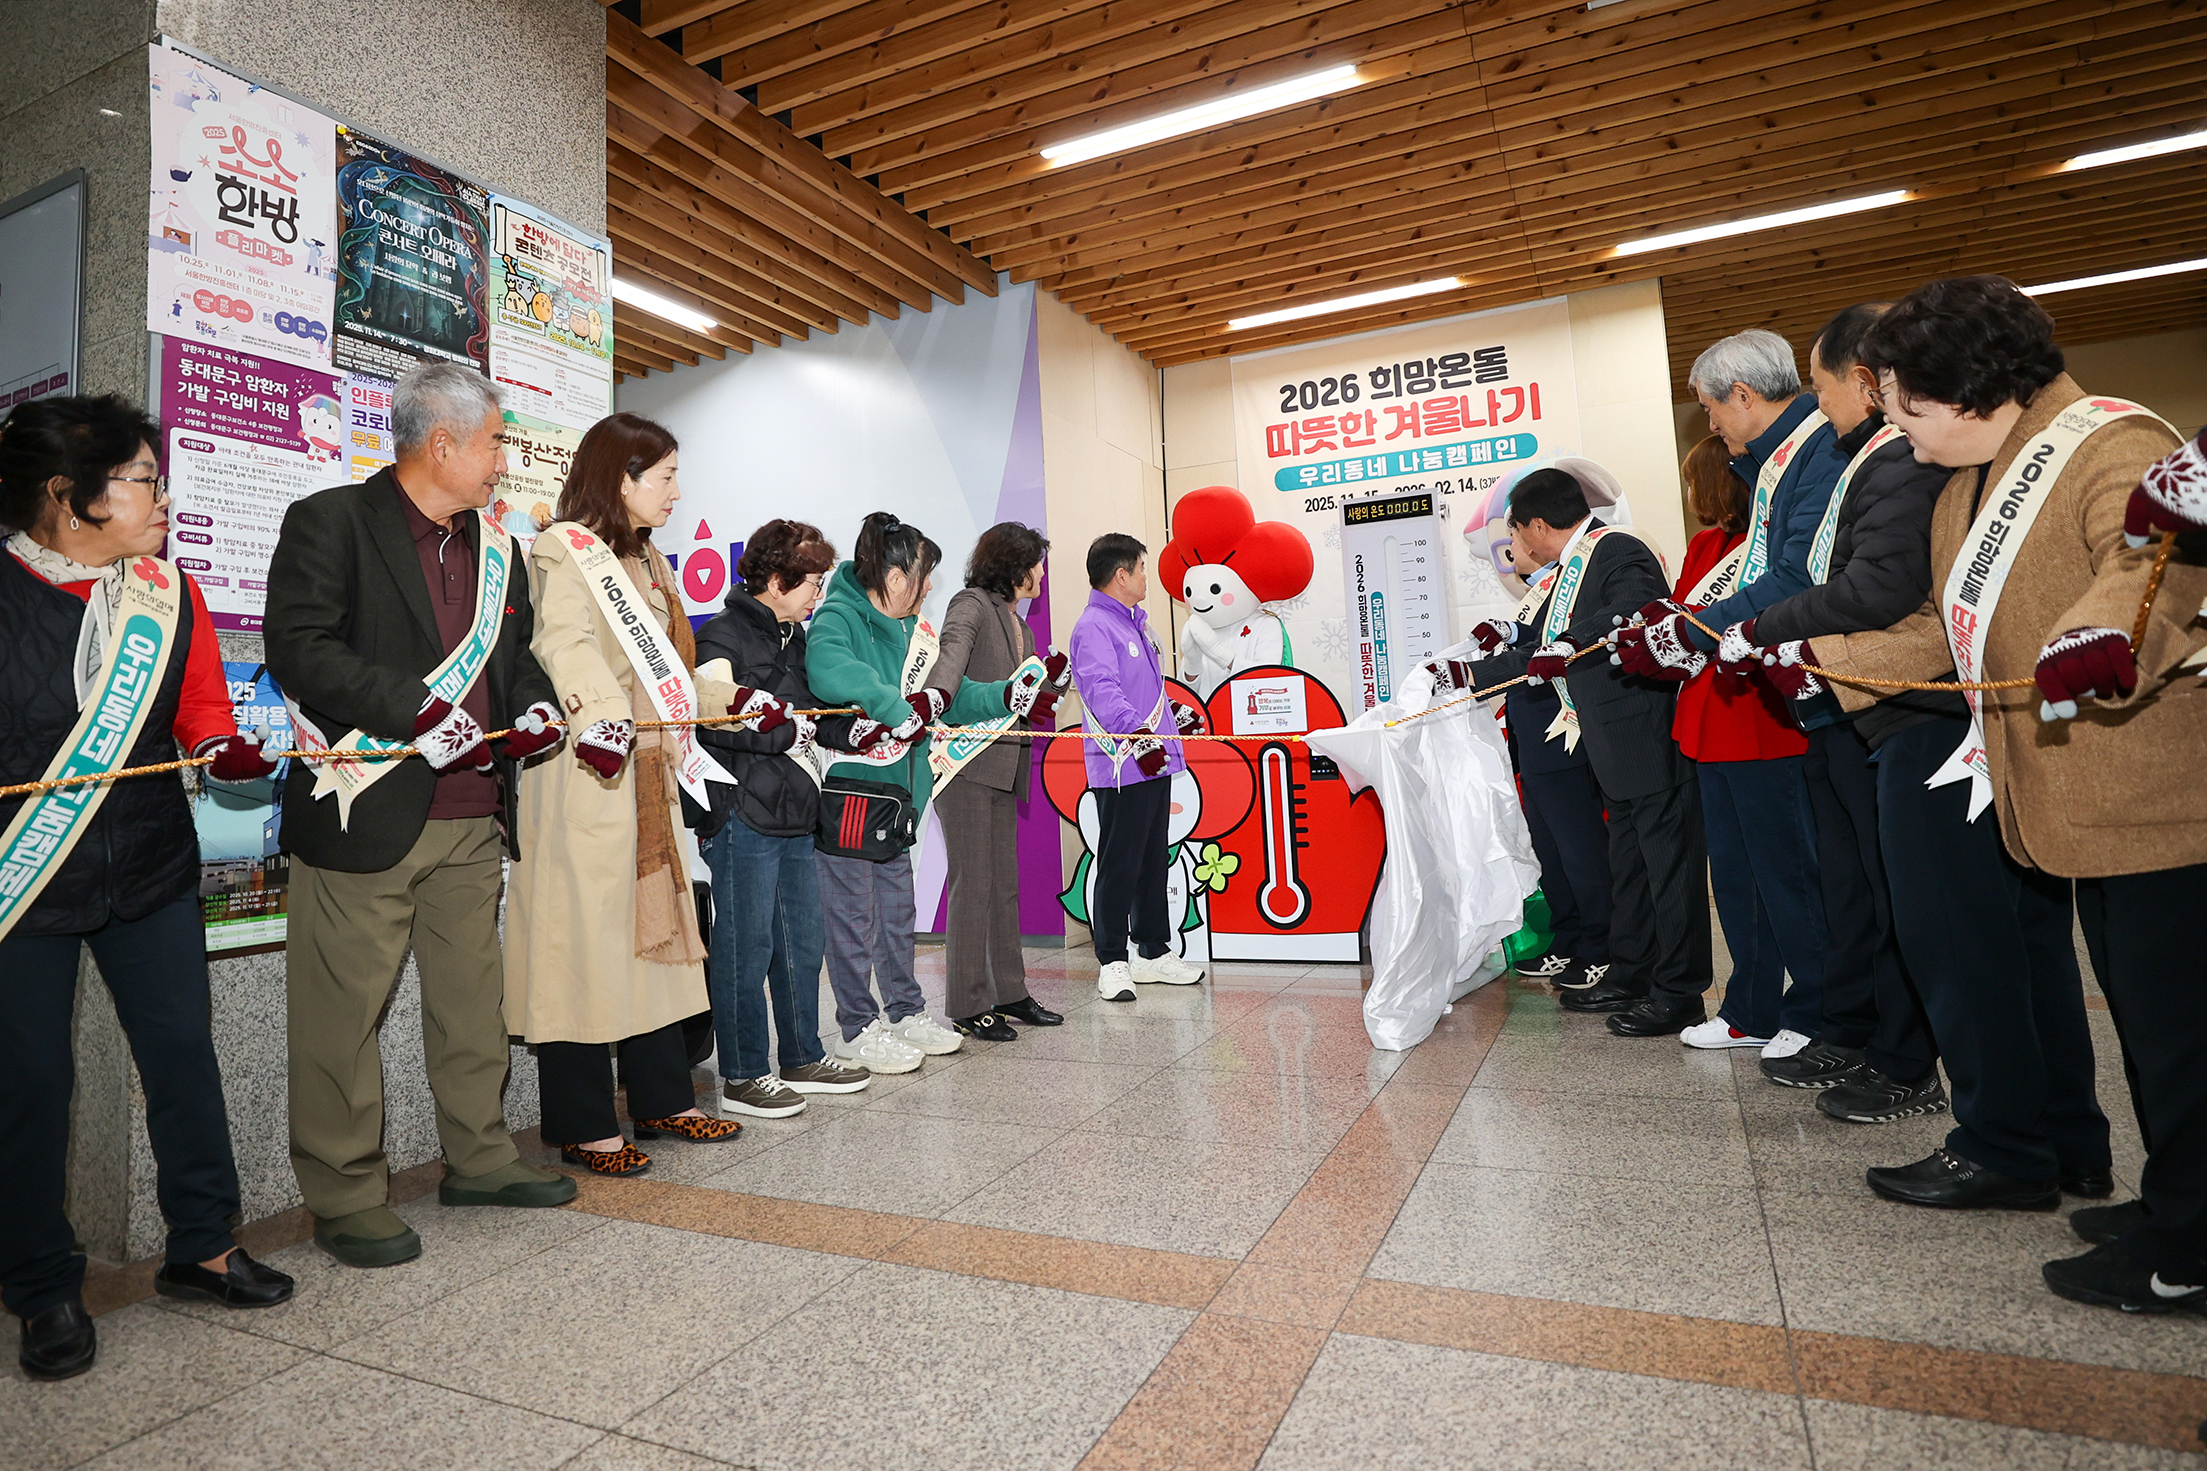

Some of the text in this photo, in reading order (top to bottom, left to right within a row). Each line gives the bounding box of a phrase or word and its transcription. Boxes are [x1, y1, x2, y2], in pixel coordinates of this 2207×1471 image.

[204, 127, 226, 138] 2025
[215, 173, 300, 243] 한방
[227, 231, 284, 263] 플리마켓
[358, 199, 427, 239] CONCERT
[429, 226, 473, 260] OPERA
[522, 223, 560, 252] 한방에
[563, 241, 587, 265] 담다
[378, 227, 457, 271] 콘서트 오페라
[384, 252, 404, 266] 사랑의
[405, 260, 419, 272] 묘약
[515, 237, 555, 264] 콘텐츠
[557, 255, 592, 283] 공모전
[185, 269, 240, 291] 서울한방진흥센터
[248, 266, 265, 275] 2025
[181, 343, 260, 369] 암환자 치료 극복 지원!!
[179, 358, 289, 398] 동대문구 암환자
[1280, 345, 1509, 414] 2026 희망온돌
[177, 381, 290, 420] 가발 구입비 지원
[184, 407, 207, 417] 신청장소
[211, 412, 247, 426] 동대문구보건소
[258, 422, 283, 433] 보건행정과
[184, 417, 206, 428] 신청문의
[210, 423, 231, 434] 동대문구
[233, 428, 259, 439] 보건행정과
[1266, 382, 1542, 458] 따뜻한 겨울나기
[183, 439, 211, 452] 지원대상
[219, 447, 231, 455] 아래
[351, 430, 381, 450] 무료
[502, 435, 577, 476] 배봉산정
[1299, 437, 1518, 487] 우리동네 나눔캠페인
[1304, 497, 1338, 513] 2025.
[1458, 478, 1477, 493] 14.
[1999, 443, 2055, 520] 2026
[181, 514, 208, 525] 지원내용
[216, 519, 229, 528] 가발
[257, 525, 270, 533] 90%
[1348, 506, 1369, 521] 사랑의
[1370, 504, 1385, 518] 온도
[1421, 498, 1429, 511] 도
[181, 532, 208, 543] 구비서류
[223, 537, 248, 547] 항암치료
[224, 547, 236, 555] 가발
[238, 549, 256, 558] 구입비
[180, 559, 207, 569] 지원절차
[230, 565, 242, 573] 구입
[1415, 556, 1425, 564] 90
[1959, 520, 2011, 607] 희망온돌
[477, 557, 504, 650] 우리동네
[1421, 612, 1430, 620] 60
[1550, 566, 1580, 636] 우리동네
[600, 575, 638, 626] 2026
[628, 622, 672, 680] 희망온돌
[1355, 554, 1376, 713] 2026 희망온돌 따뜻한 겨울
[910, 648, 929, 684] 2026
[1372, 598, 1390, 698] 우리동네 나눔캠페인
[1423, 650, 1433, 658] 40
[79, 632, 156, 766] 우리동네
